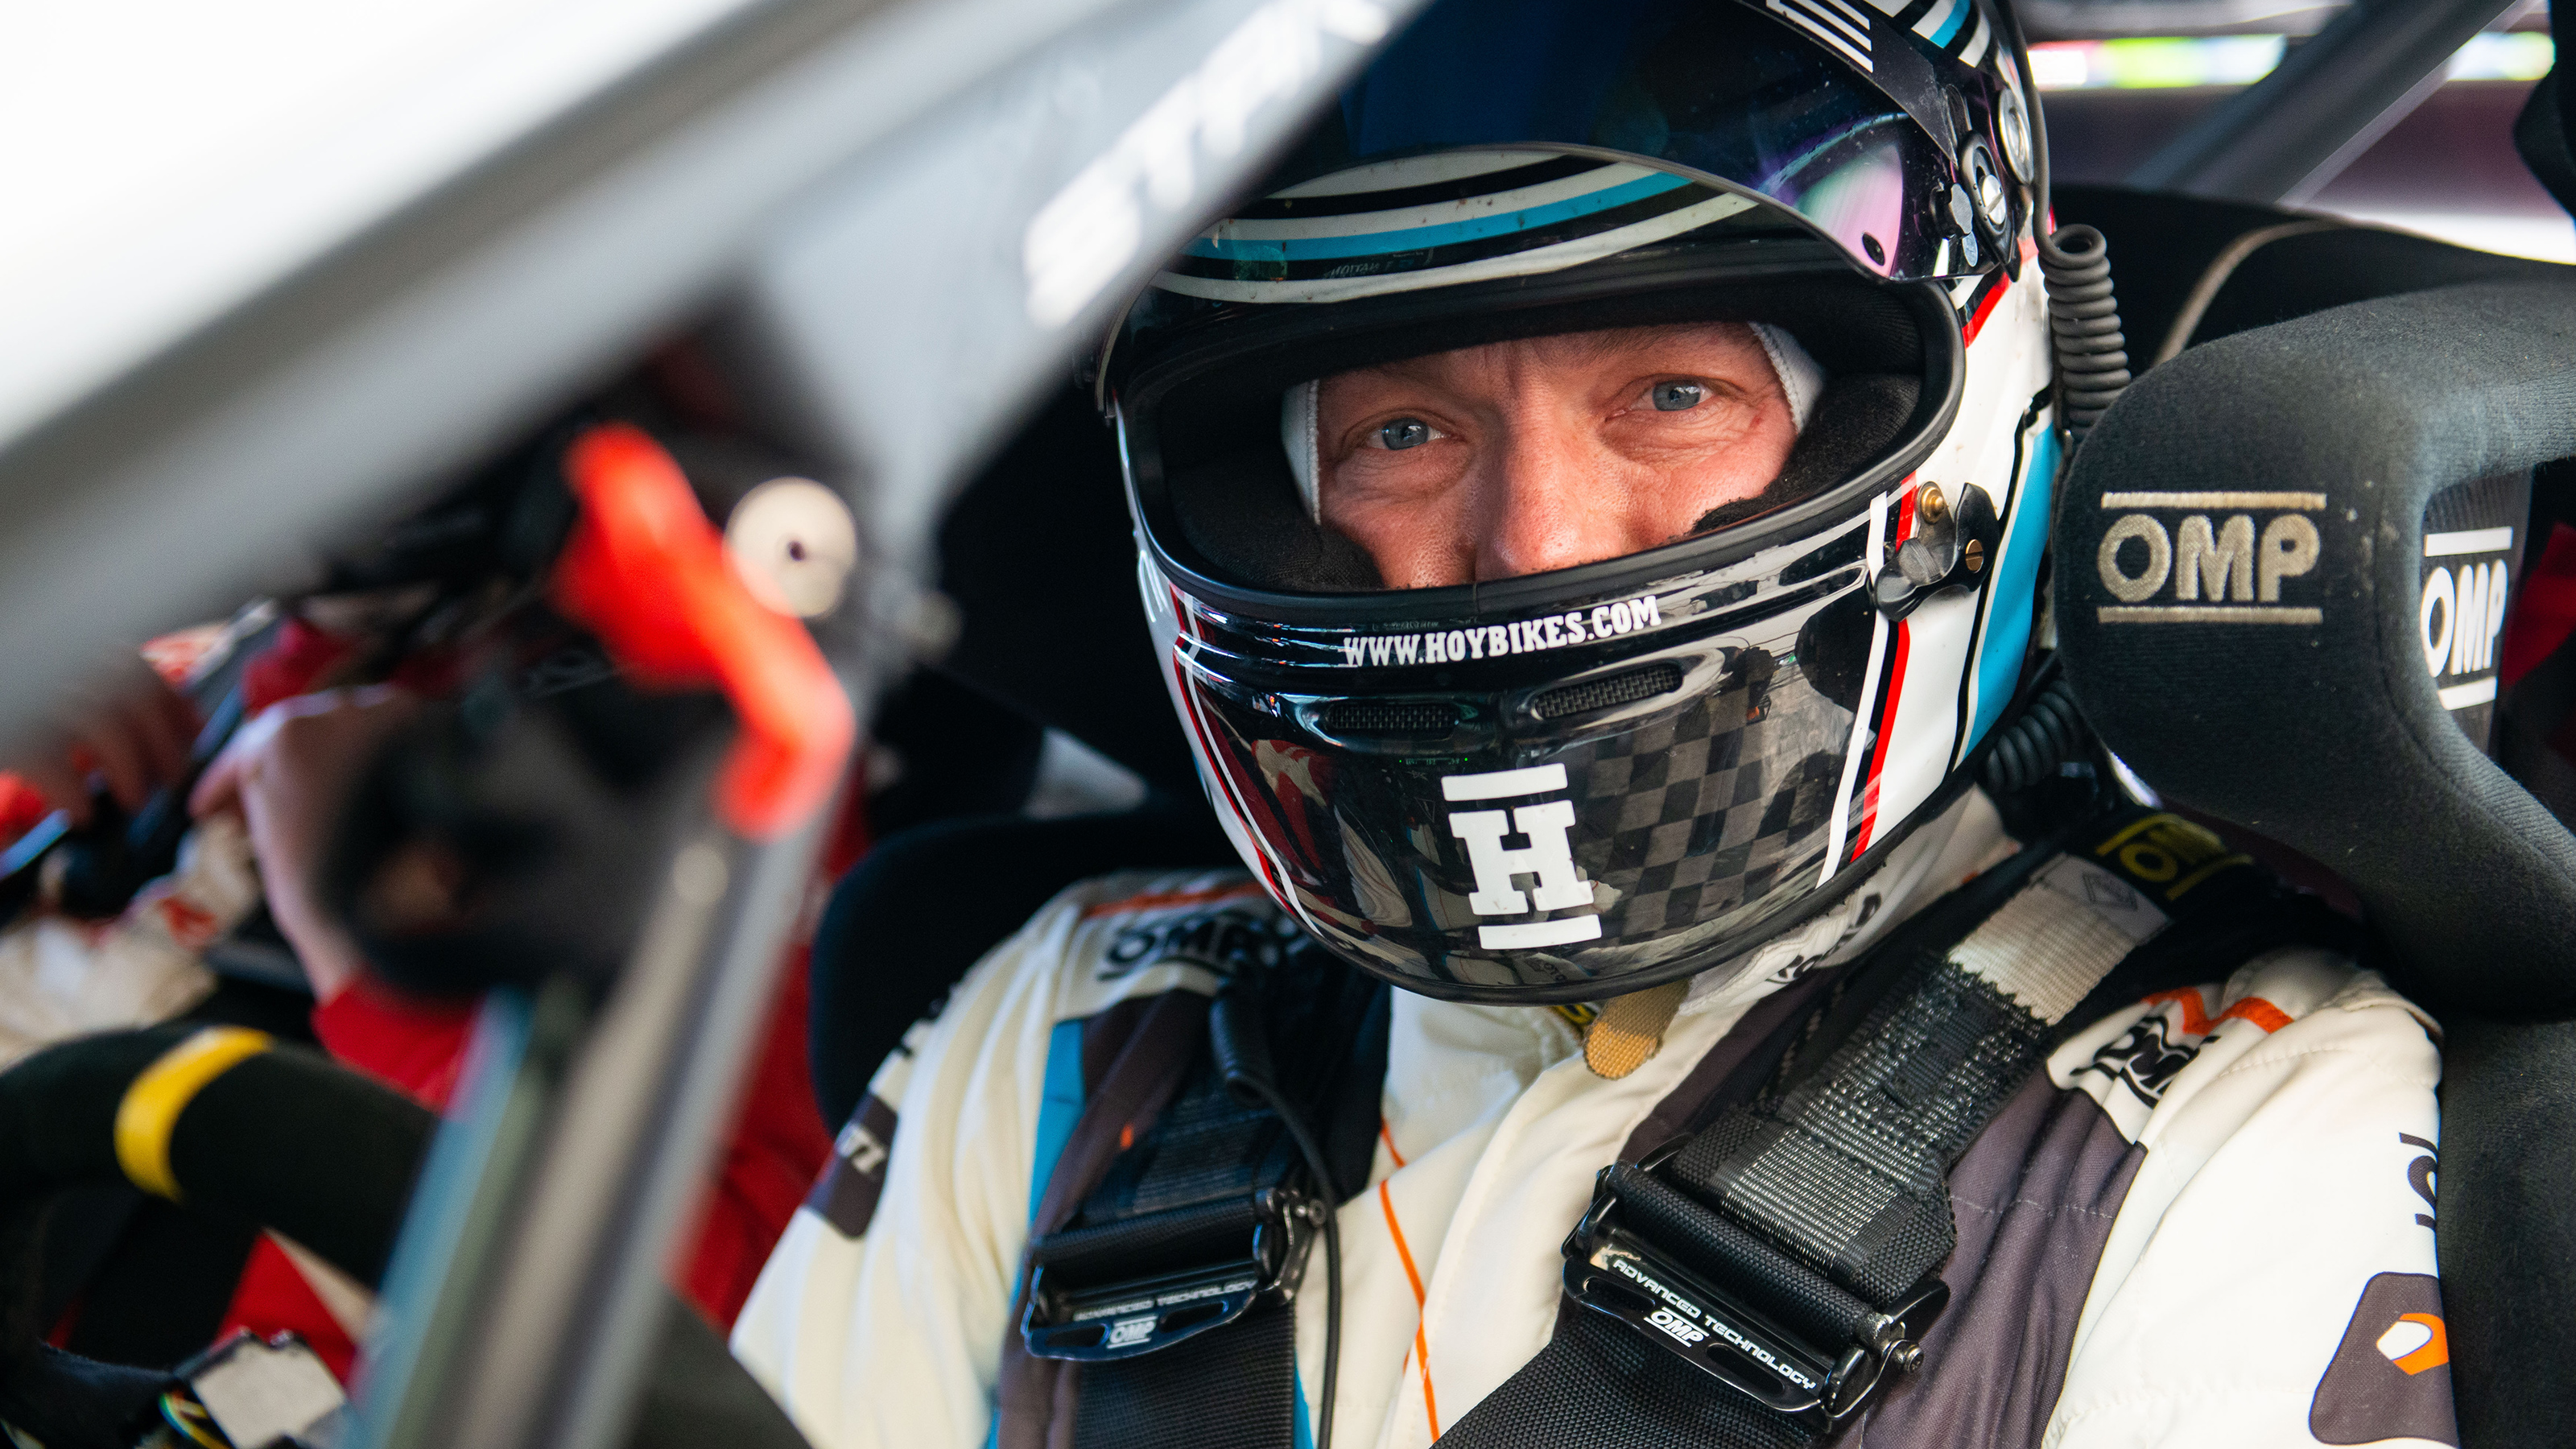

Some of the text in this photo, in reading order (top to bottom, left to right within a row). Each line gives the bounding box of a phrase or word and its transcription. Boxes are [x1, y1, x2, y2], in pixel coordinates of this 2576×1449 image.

[2097, 514, 2320, 603] OMP
[1343, 594, 1662, 667] WWW.HOYBIKES.COM
[2421, 559, 2508, 678] OMP
[1449, 799, 1595, 916] H
[1109, 1320, 1157, 1345] OMP
[1612, 1259, 1818, 1389] ADVANCED TECHNOLOGY
[1650, 1311, 1704, 1343] OMP
